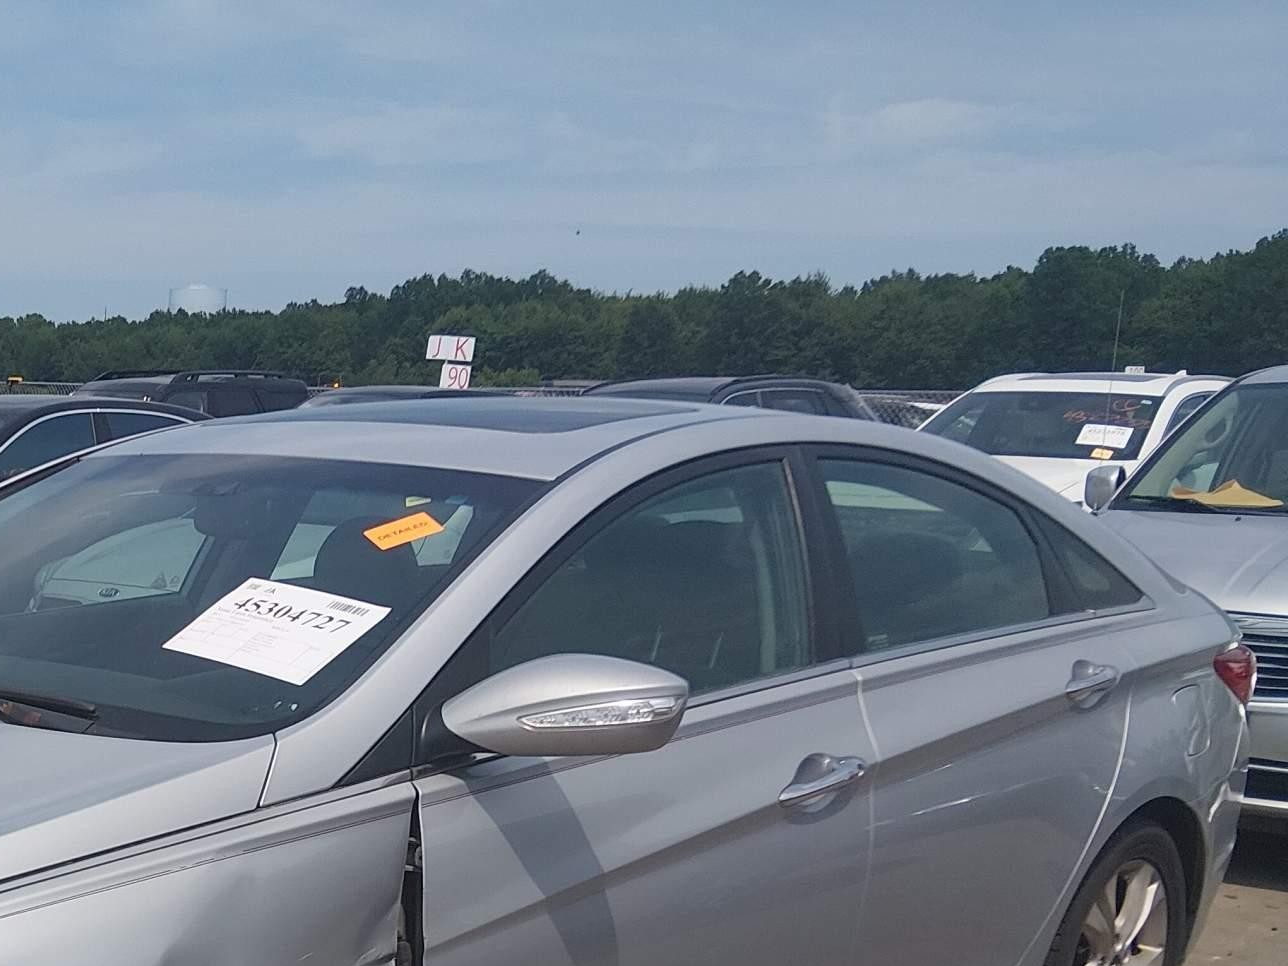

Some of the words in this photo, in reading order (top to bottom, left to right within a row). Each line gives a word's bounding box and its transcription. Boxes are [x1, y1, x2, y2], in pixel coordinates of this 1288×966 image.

[432, 337, 442, 358] J
[455, 337, 470, 360] K
[447, 366, 469, 389] 90
[234, 597, 352, 633] 45304727
